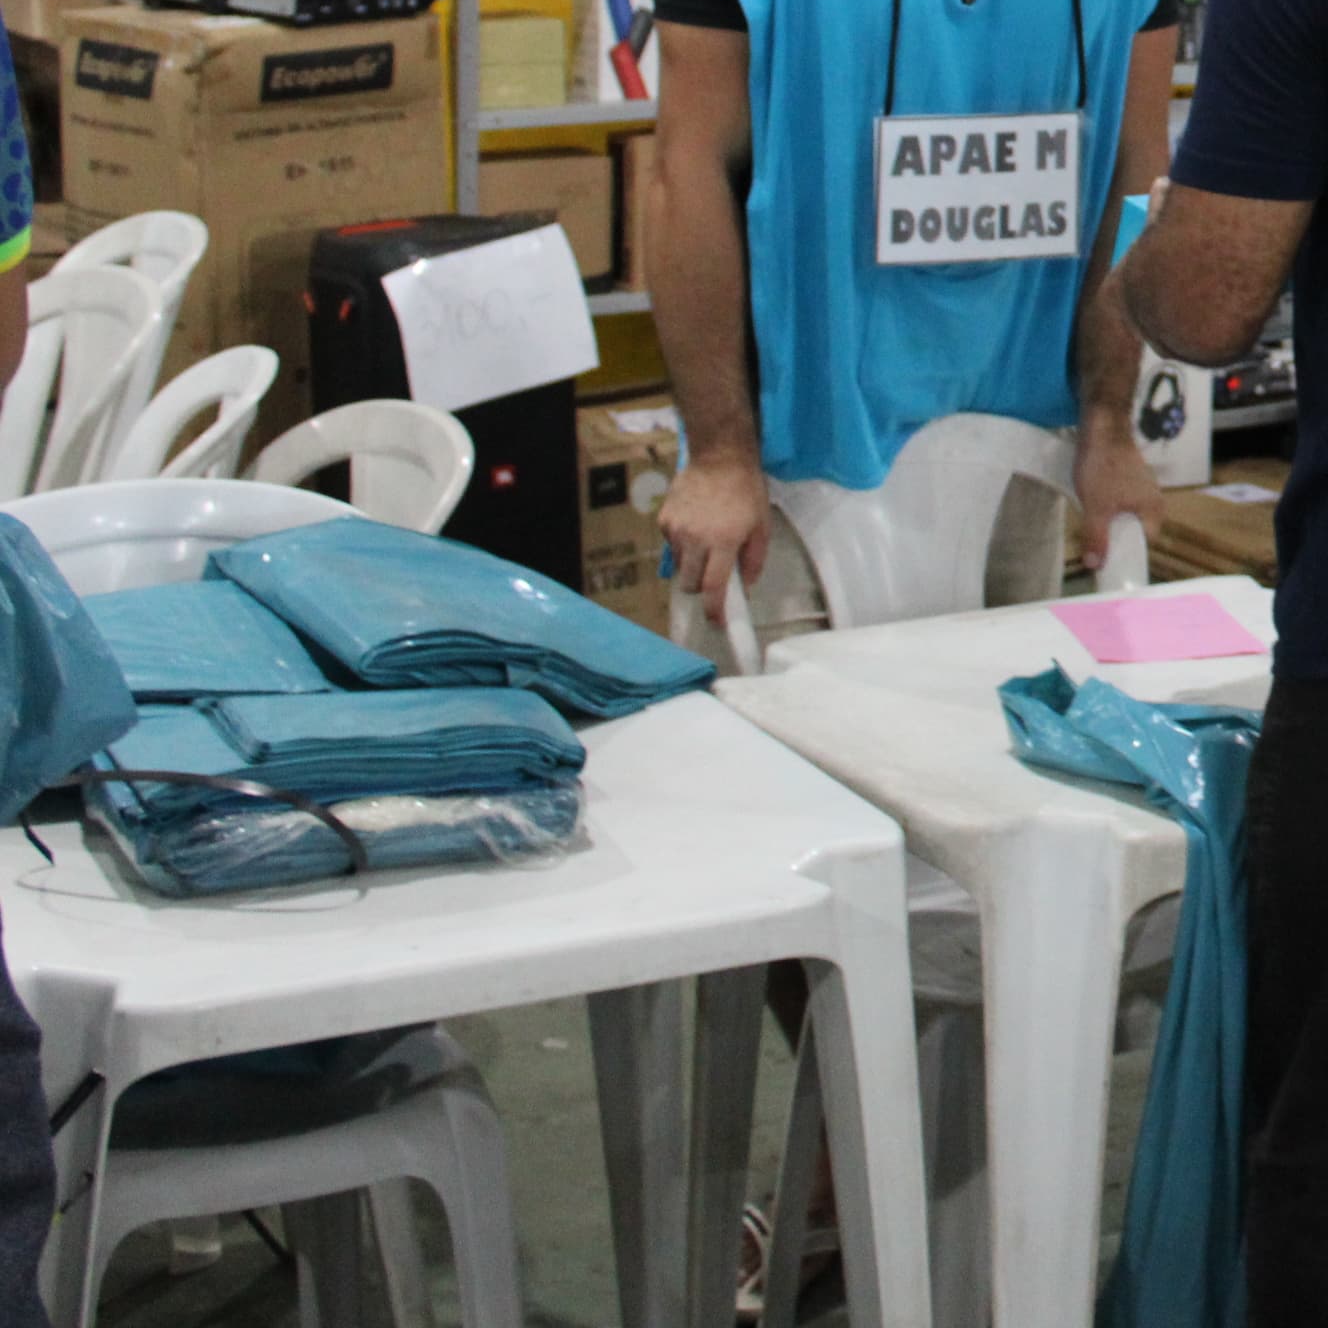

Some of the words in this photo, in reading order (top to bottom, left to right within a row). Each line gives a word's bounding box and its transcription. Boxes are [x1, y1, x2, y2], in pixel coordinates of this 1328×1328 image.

[891, 132, 1017, 177] APAE
[1035, 129, 1067, 170] M
[890, 201, 1068, 245] DOUGLAS
